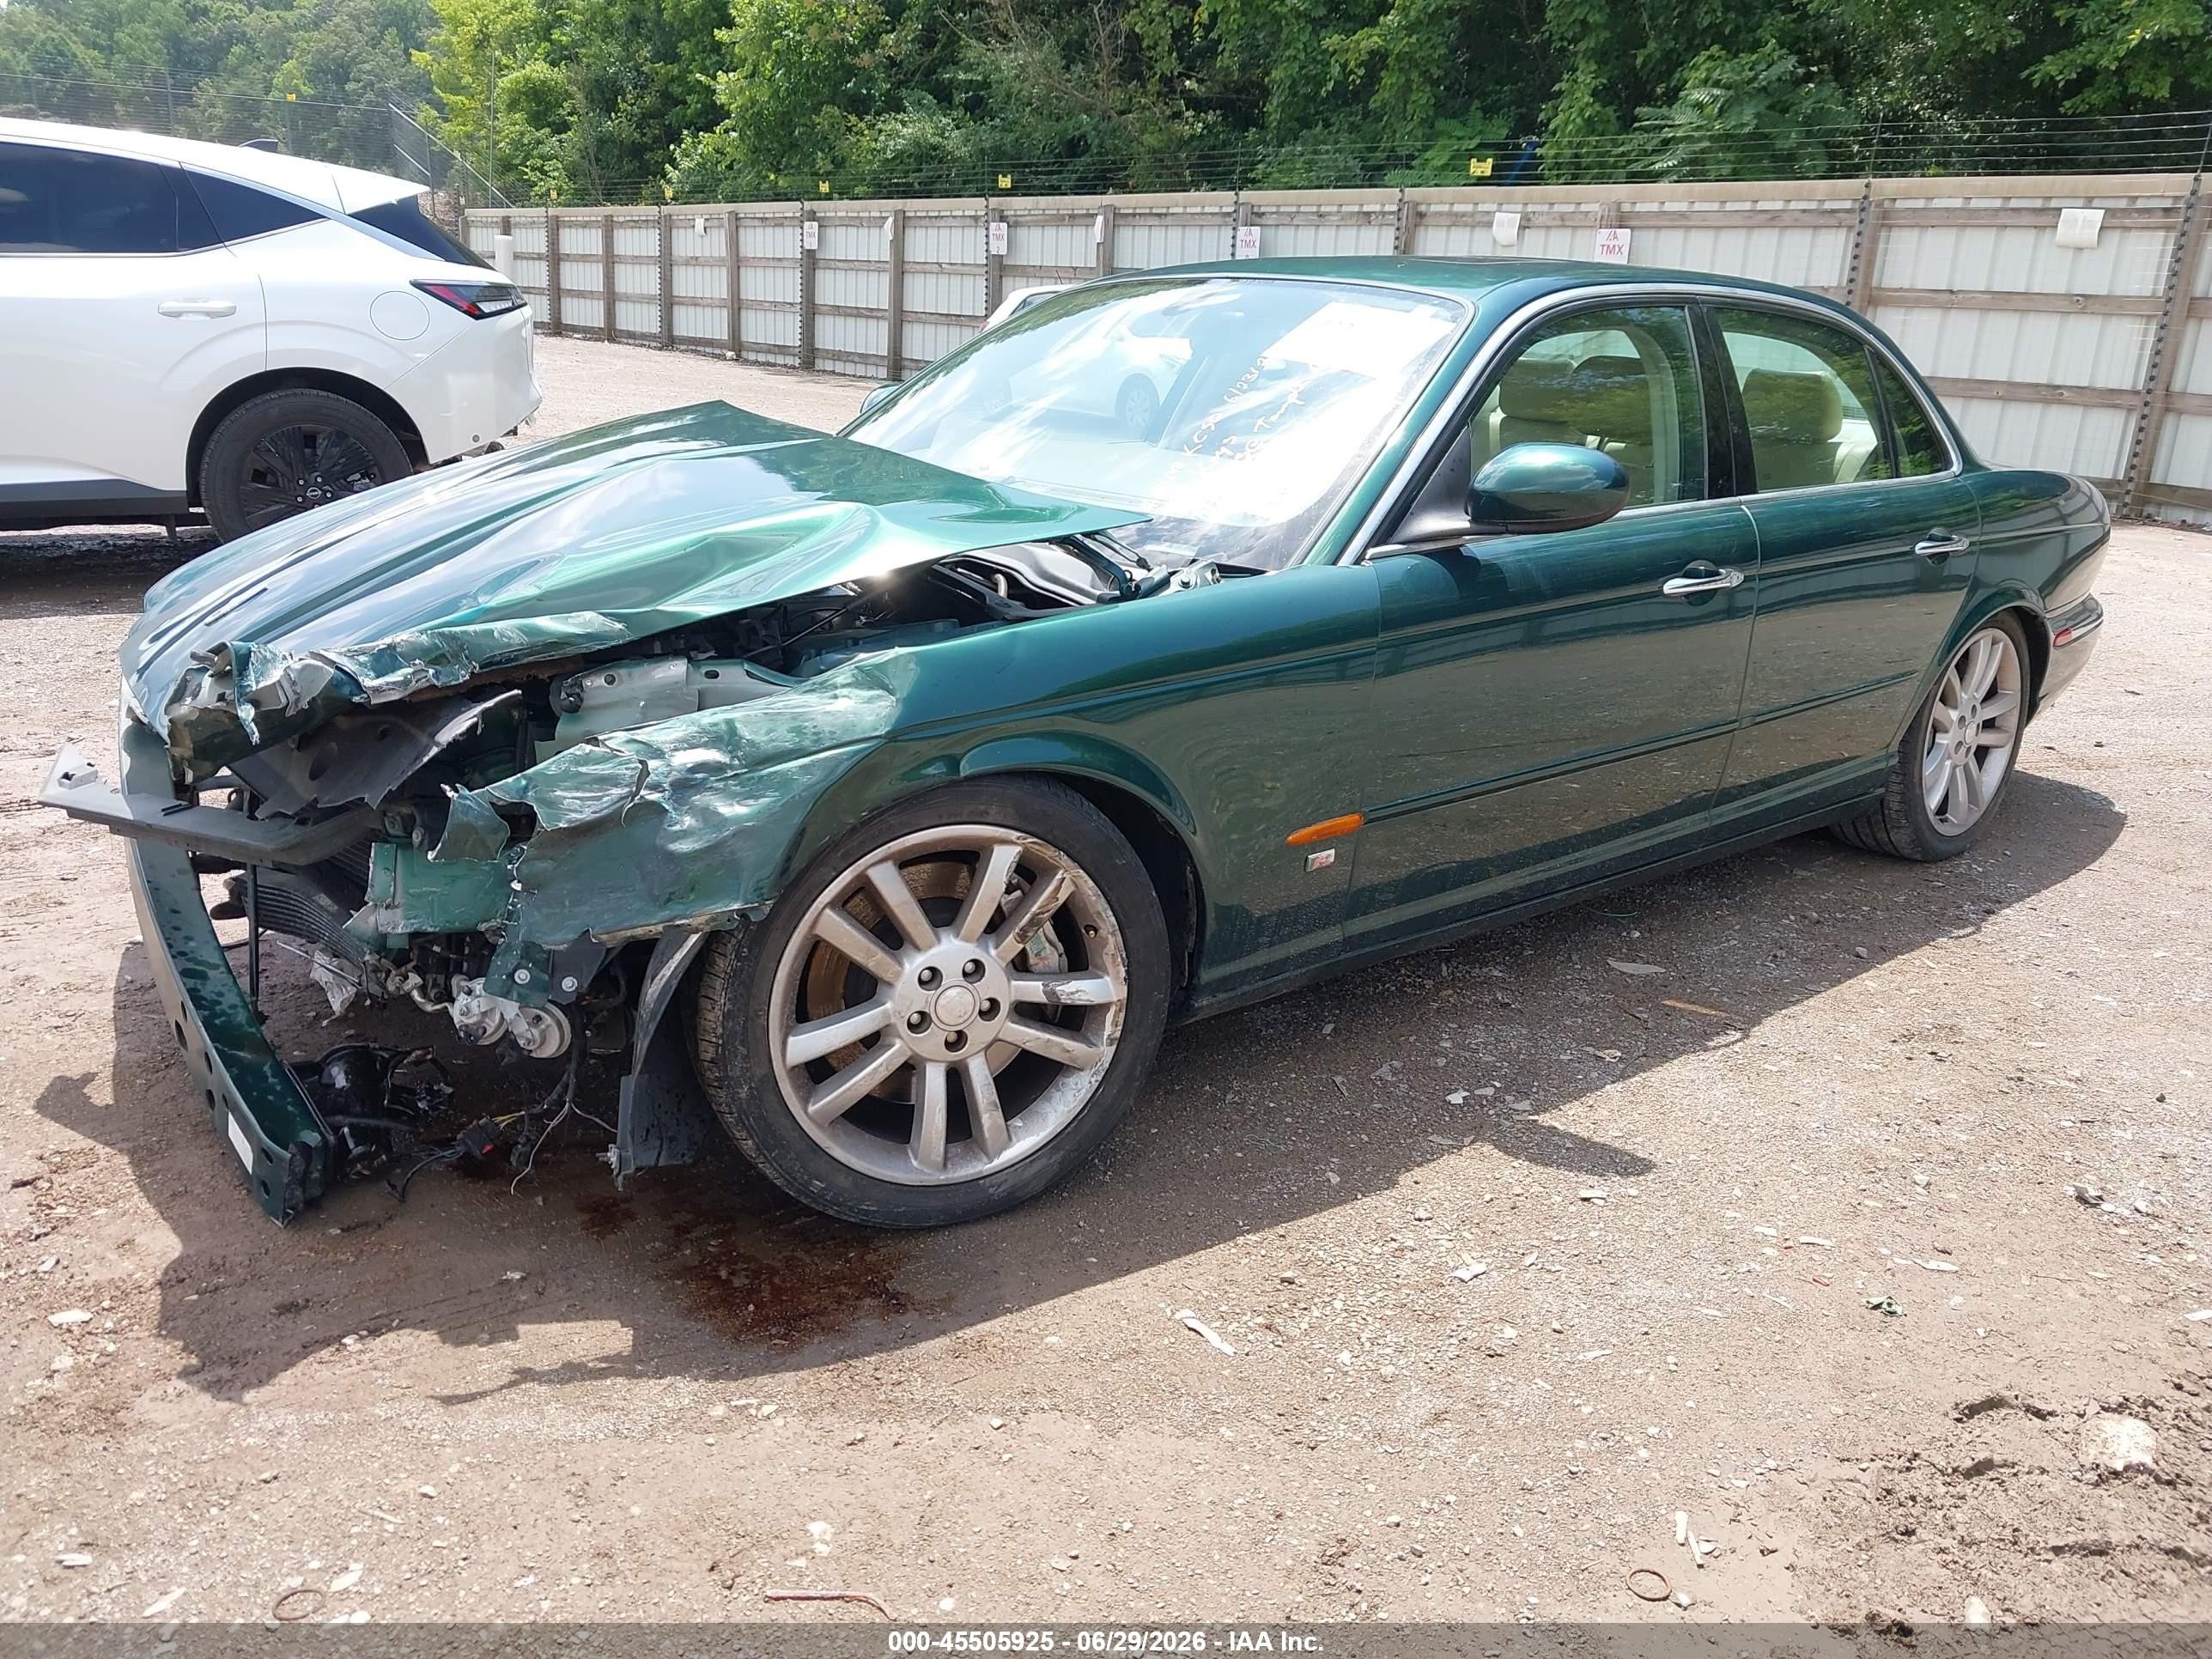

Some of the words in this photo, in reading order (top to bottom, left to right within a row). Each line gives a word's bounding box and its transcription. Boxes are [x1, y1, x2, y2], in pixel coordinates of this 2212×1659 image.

[992, 233, 1005, 241] TMX
[1241, 239, 1257, 248] TMX
[1600, 243, 1625, 255] TMX
